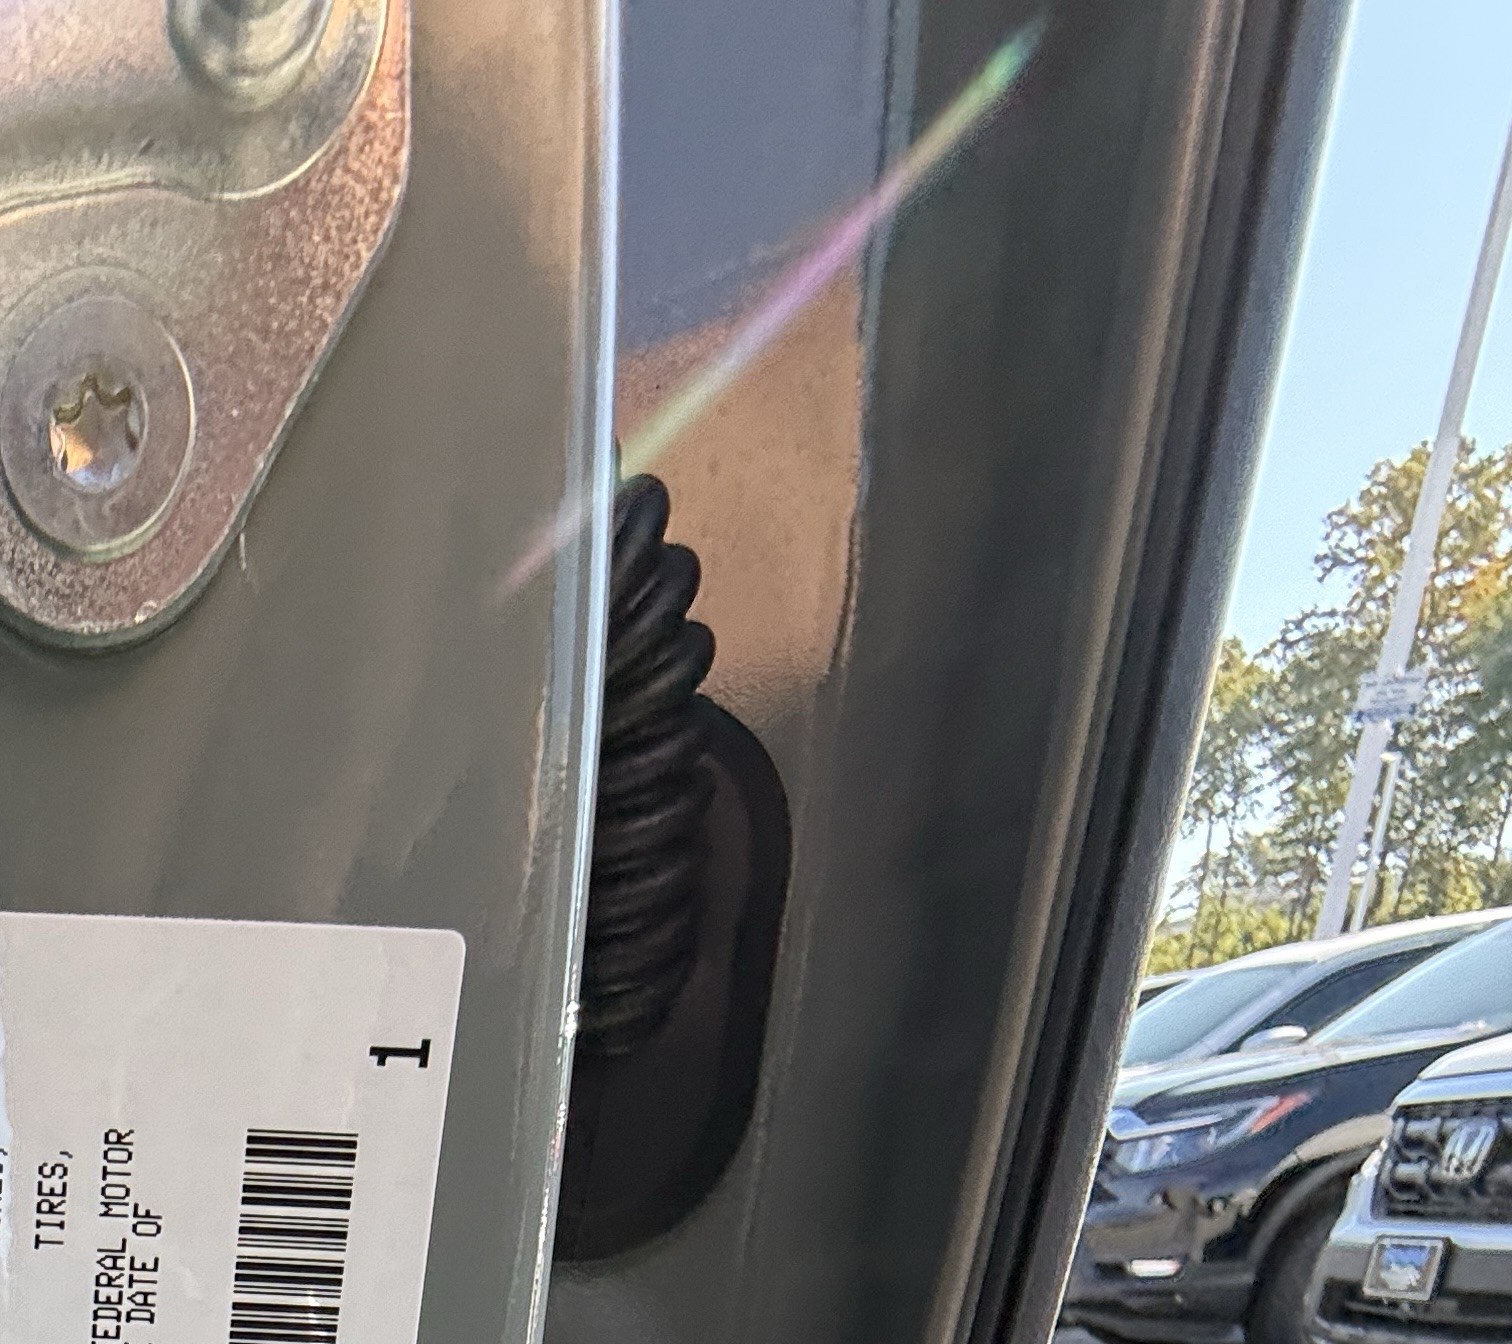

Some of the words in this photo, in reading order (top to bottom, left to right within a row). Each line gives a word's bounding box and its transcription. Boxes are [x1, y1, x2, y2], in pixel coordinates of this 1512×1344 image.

[369, 1038, 432, 1069] 1
[34, 1150, 73, 1250] TIRES,
[98, 1128, 135, 1219] MOTOR
[131, 1202, 163, 1238] OF
[125, 1255, 160, 1325] DATE
